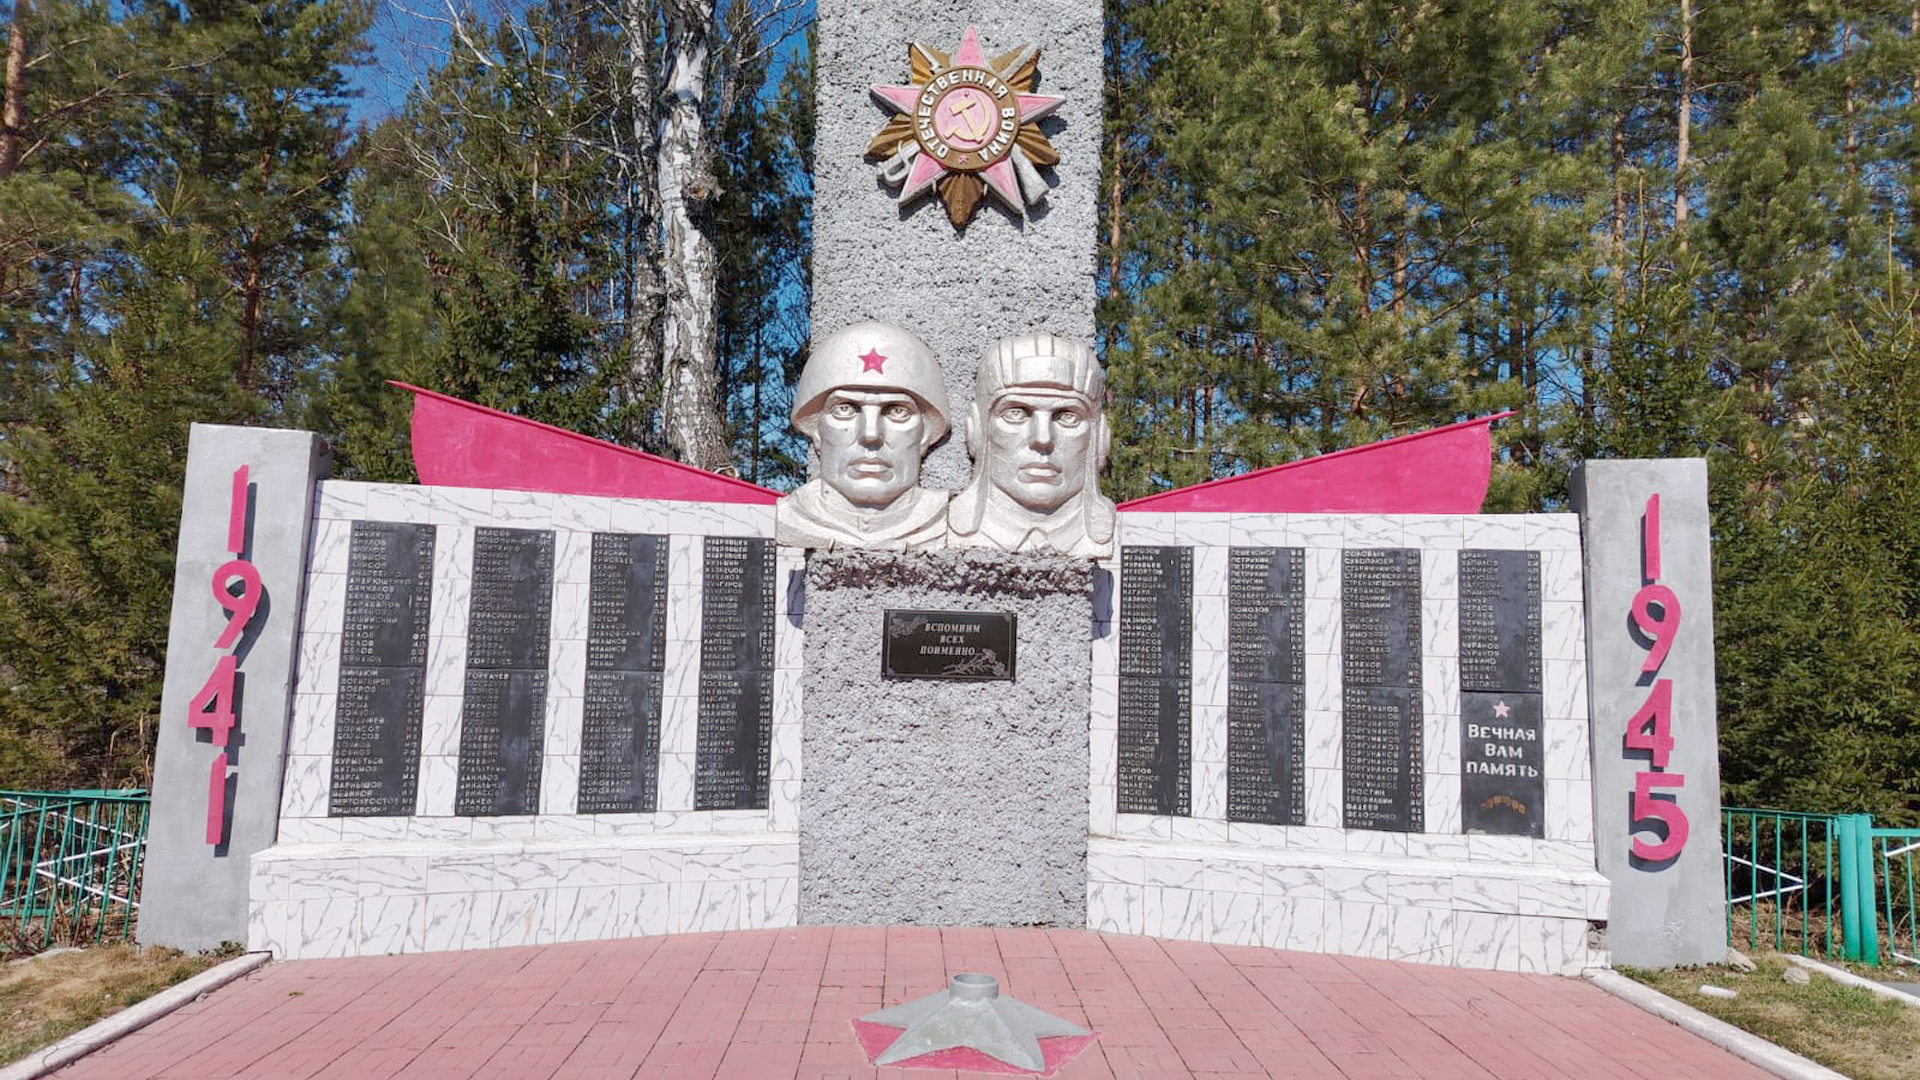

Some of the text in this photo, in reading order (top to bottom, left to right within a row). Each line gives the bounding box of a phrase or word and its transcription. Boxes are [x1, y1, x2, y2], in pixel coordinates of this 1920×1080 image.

[918, 69, 1008, 159] ОТЕЧЕСТВЕННАЯ
[925, 623, 980, 632] ВСПОМНИМ
[940, 635, 964, 643] ВСЕХ
[1468, 724, 1536, 741] ВЕЧНАЯ
[1485, 743, 1523, 758] ВАМ
[1466, 761, 1538, 778] ПАМЯТЬ
